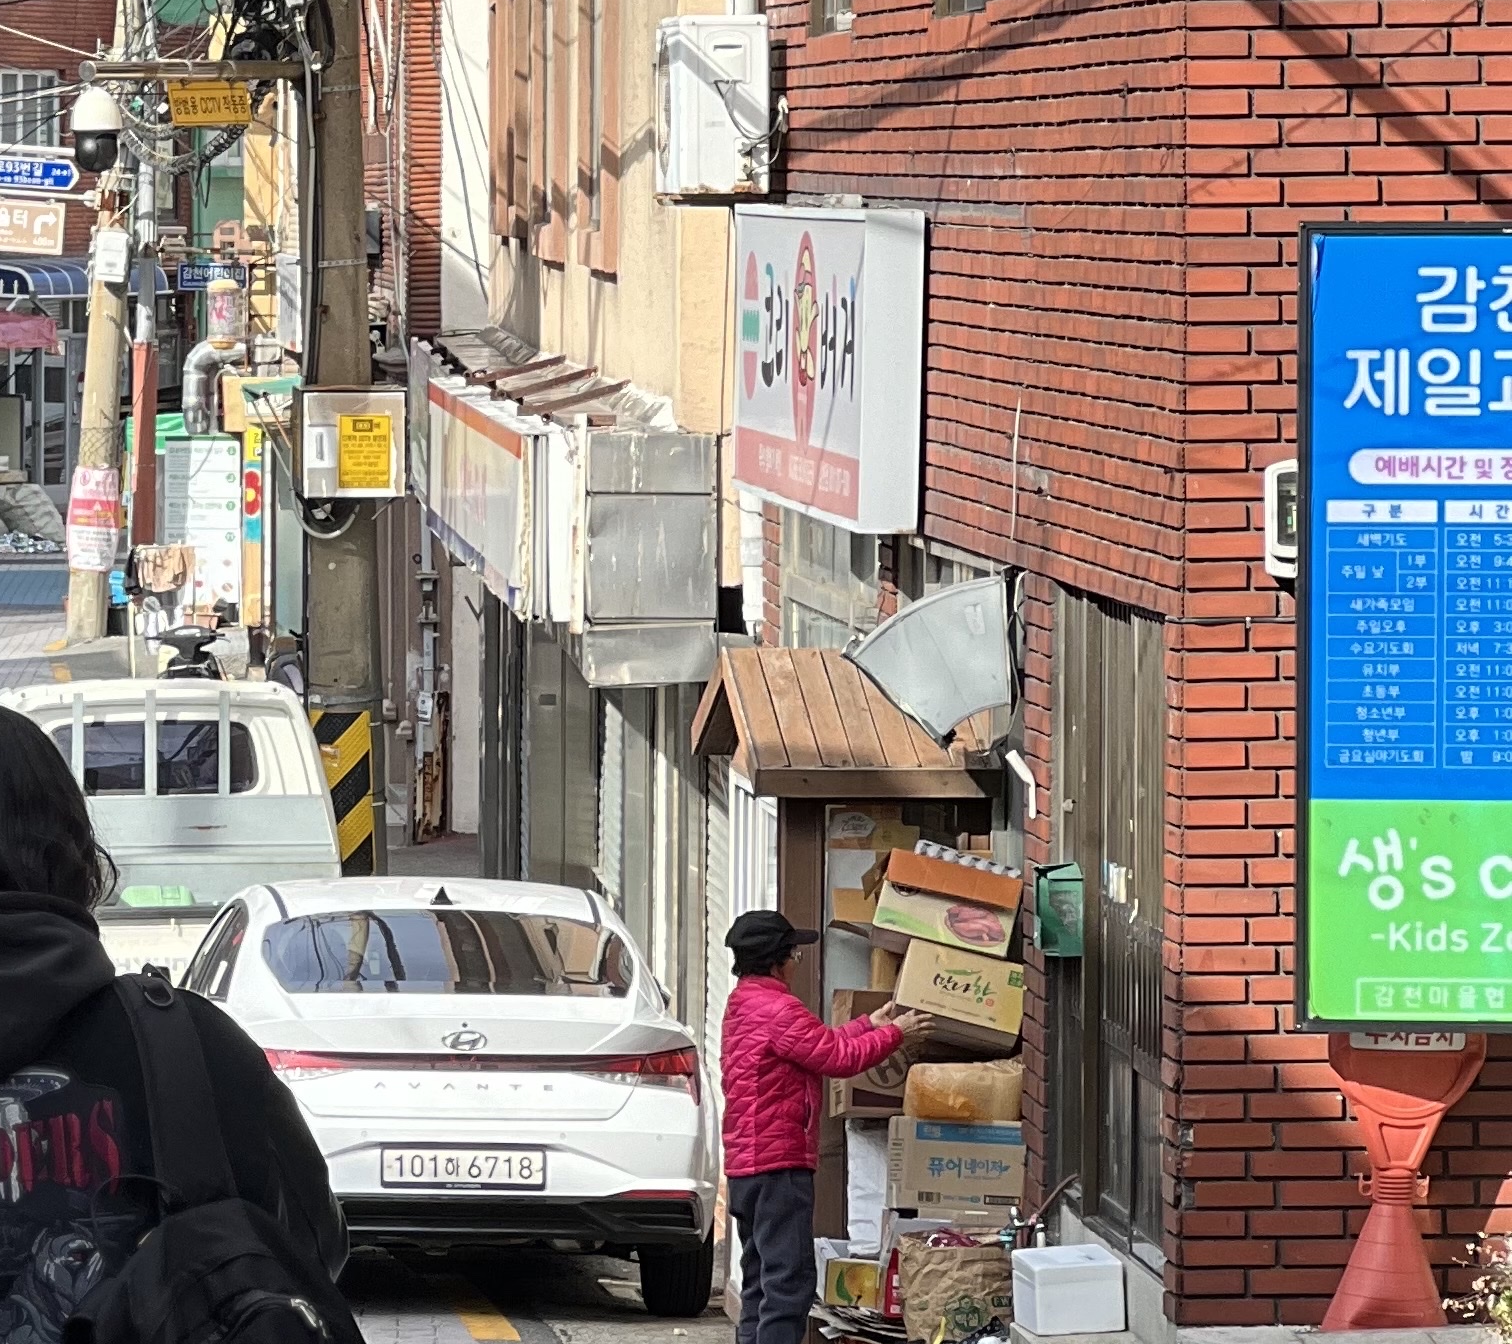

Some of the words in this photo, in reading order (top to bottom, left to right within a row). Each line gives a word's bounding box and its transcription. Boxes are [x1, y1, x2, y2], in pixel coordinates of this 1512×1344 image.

[1374, 456, 1467, 479] 예배시간
[1474, 458, 1493, 479] 및
[1356, 533, 1407, 547] 새벽기도
[1350, 641, 1414, 656] 수요기도회
[374, 1081, 554, 1092] AVANTE
